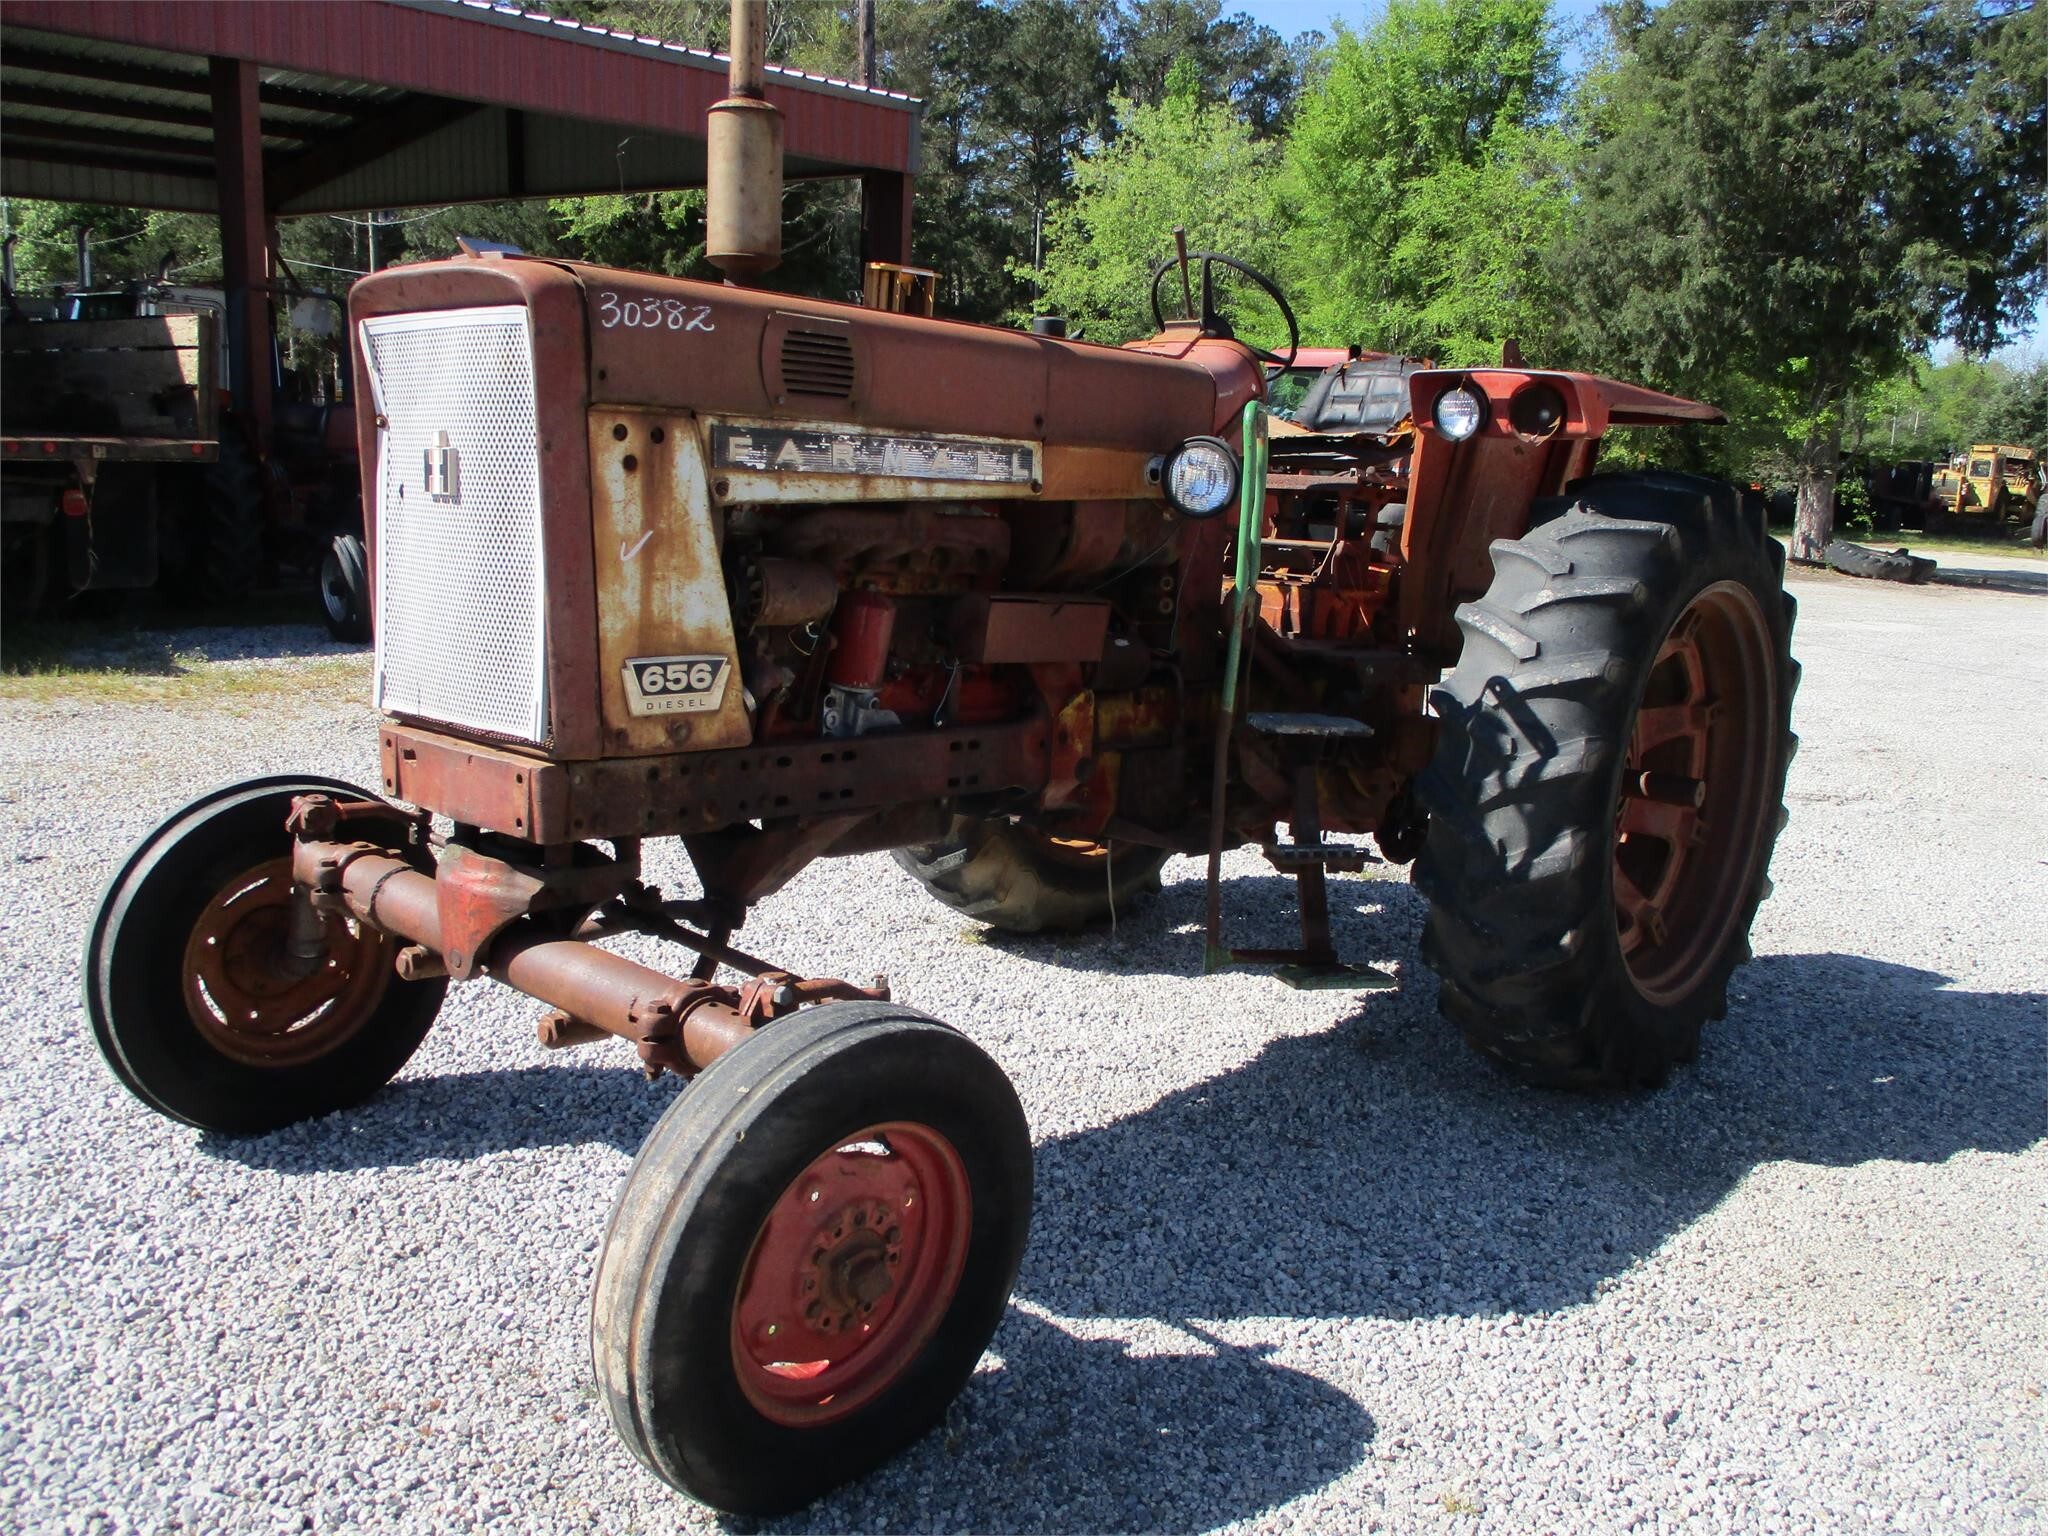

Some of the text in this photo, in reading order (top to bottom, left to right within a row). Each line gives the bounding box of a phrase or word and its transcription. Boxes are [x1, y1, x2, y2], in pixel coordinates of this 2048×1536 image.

[600, 292, 715, 331] 30382
[728, 436, 1031, 478] FARMALL
[641, 662, 713, 693] 656
[646, 699, 706, 710] DIESEL
